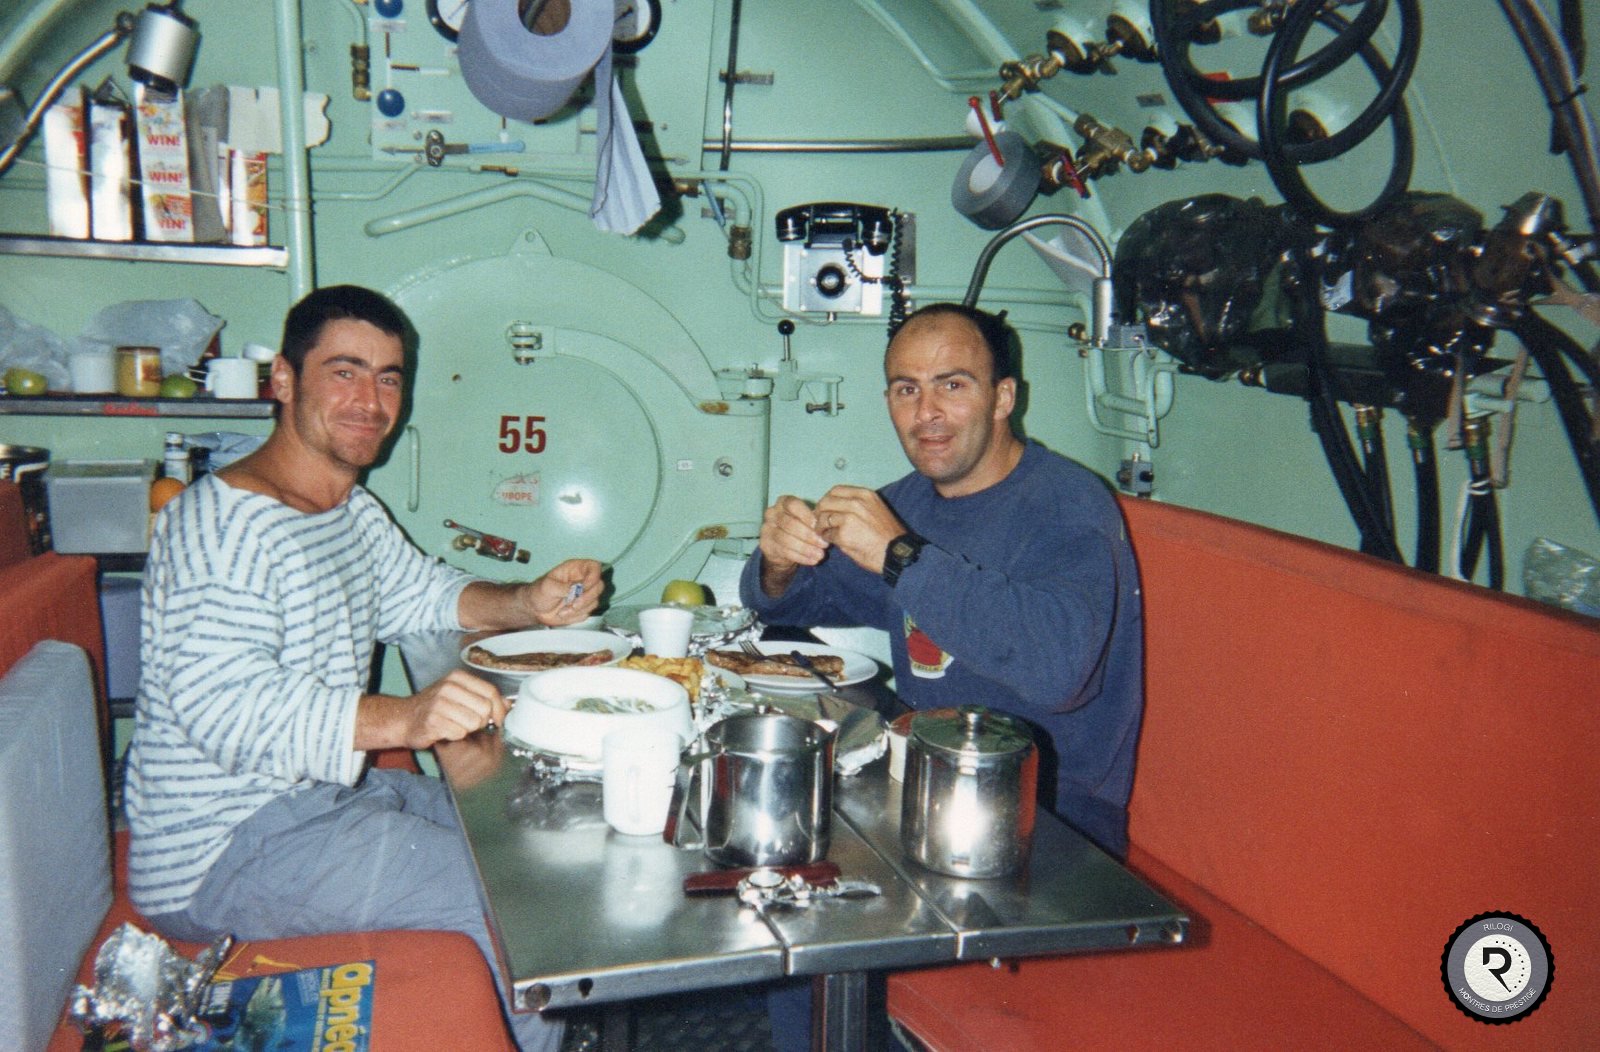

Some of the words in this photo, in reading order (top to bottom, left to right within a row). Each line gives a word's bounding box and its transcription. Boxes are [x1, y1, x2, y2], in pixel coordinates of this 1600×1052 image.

[146, 134, 181, 145] WIN!
[149, 171, 183, 182] WIN!
[498, 415, 547, 454] 55
